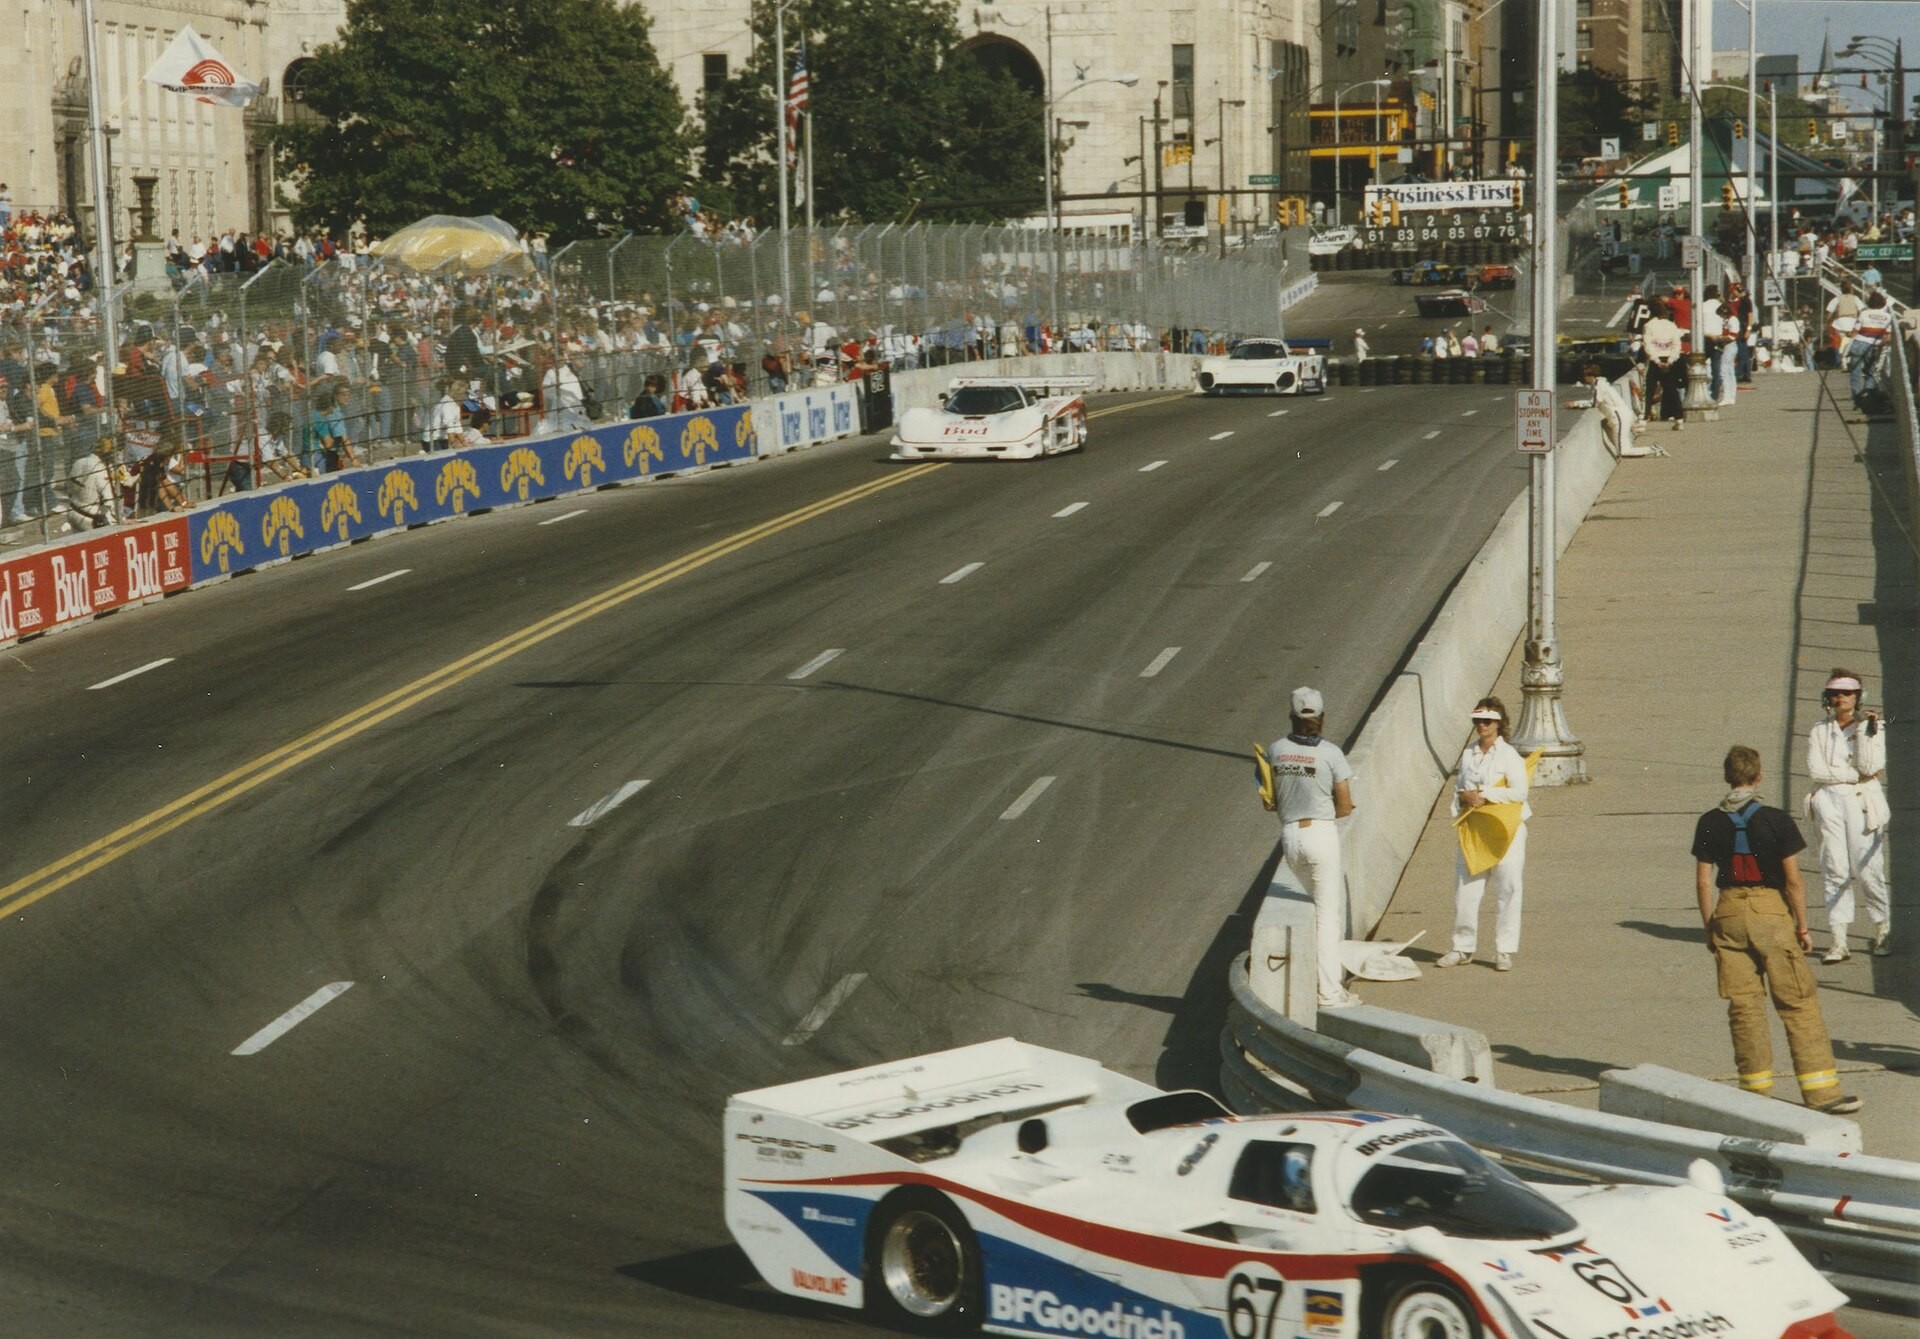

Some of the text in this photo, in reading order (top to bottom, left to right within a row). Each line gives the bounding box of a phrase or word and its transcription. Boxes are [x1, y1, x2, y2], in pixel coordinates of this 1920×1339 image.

[1376, 184, 1512, 203] Business First
[1366, 212, 1513, 228] LP 1 2 3 4 5
[1368, 230, 1384, 241] 61
[1422, 229, 1438, 240] 84
[1449, 228, 1465, 239] 85
[1474, 227, 1490, 238] 67
[1499, 226, 1515, 237] 76
[1857, 248, 1875, 256] CIVIC
[1528, 396, 1540, 406] NO
[1520, 408, 1550, 418] STOPPING
[944, 427, 988, 435] Bud
[1526, 429, 1542, 437] TIME
[1527, 420, 1540, 428] ANY
[500, 447, 545, 493] CAMEL
[436, 458, 480, 505] CAMEL
[378, 469, 418, 517] CAMEL
[321, 483, 362, 532] CAMEL
[262, 496, 303, 547] CAMEL
[164, 532, 179, 550] KING
[201, 511, 244, 565] CAMEL
[93, 550, 109, 569] KING
[124, 531, 163, 599] Bud
[168, 551, 176, 567] OF
[18, 570, 35, 590] KING
[51, 550, 93, 622] Bud
[98, 569, 107, 585] OF
[23, 591, 33, 608] OF
[824, 1082, 1045, 1130] BFGoodrich
[736, 1132, 837, 1154] PORSCHE
[1572, 1258, 1648, 1304] 67
[990, 1283, 1185, 1339] BFGoodrich
[1227, 1273, 1284, 1339] 67
